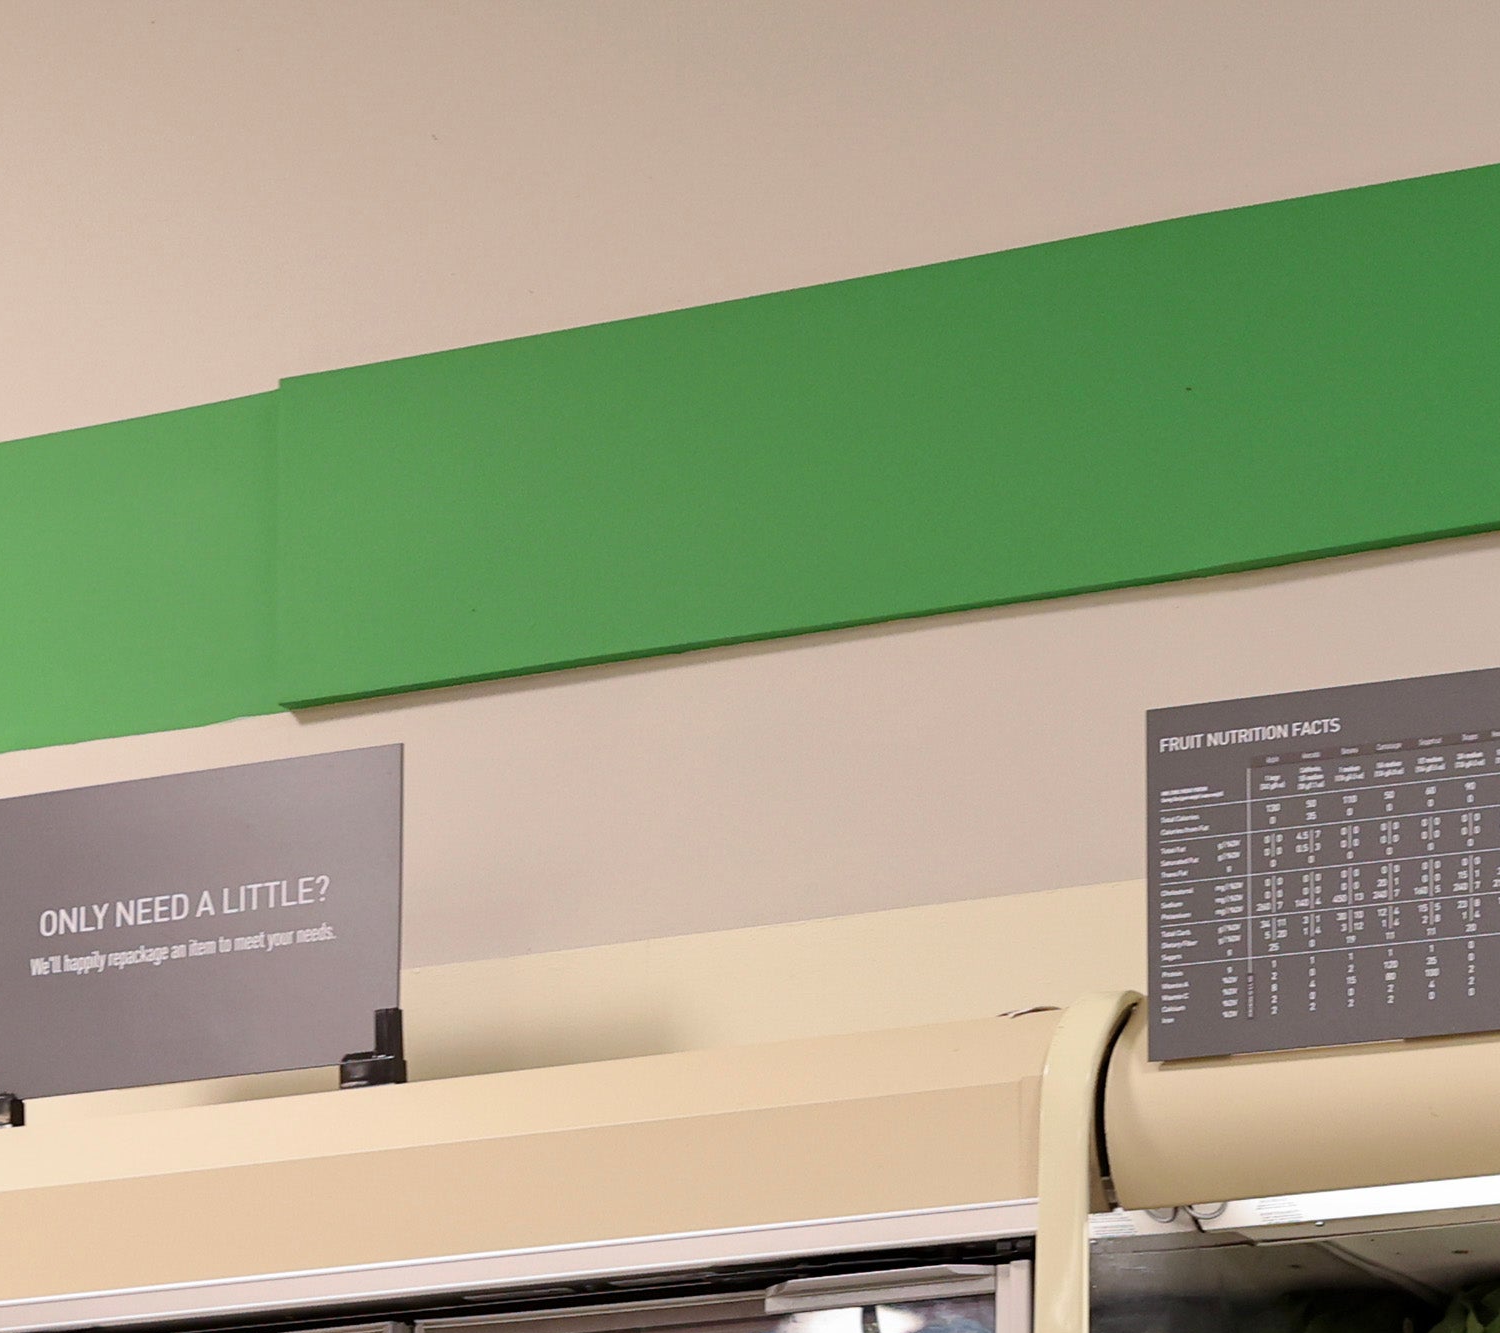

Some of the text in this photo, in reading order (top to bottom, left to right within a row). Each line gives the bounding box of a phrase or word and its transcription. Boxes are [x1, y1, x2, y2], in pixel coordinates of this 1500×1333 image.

[1159, 717, 1341, 752] FRUIT NUTRITION FACTS
[40, 874, 331, 937] ONLY NEED A LITTLE?
[29, 921, 338, 976] We'll happily repackage an item to meet your needs.
